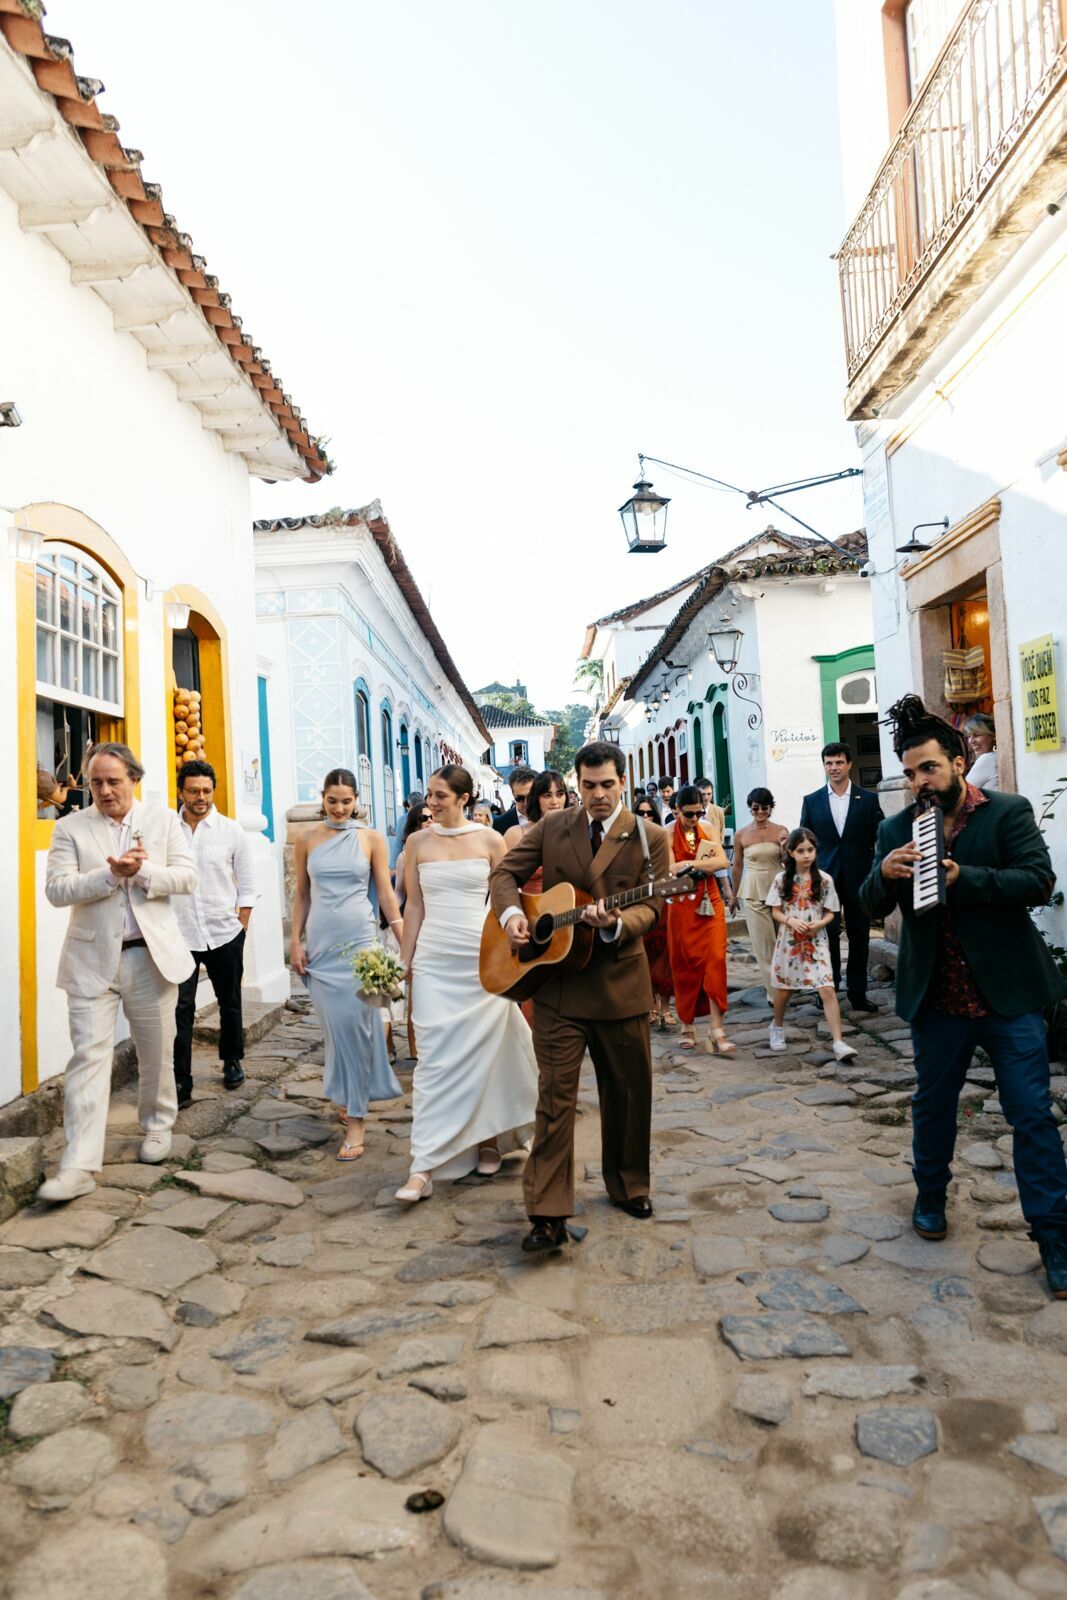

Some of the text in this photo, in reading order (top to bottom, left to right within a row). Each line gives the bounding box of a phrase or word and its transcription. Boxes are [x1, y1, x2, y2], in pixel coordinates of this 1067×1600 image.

[1027, 686, 1051, 708] NOS FAZ
[1025, 711, 1057, 742] FLORESCER
